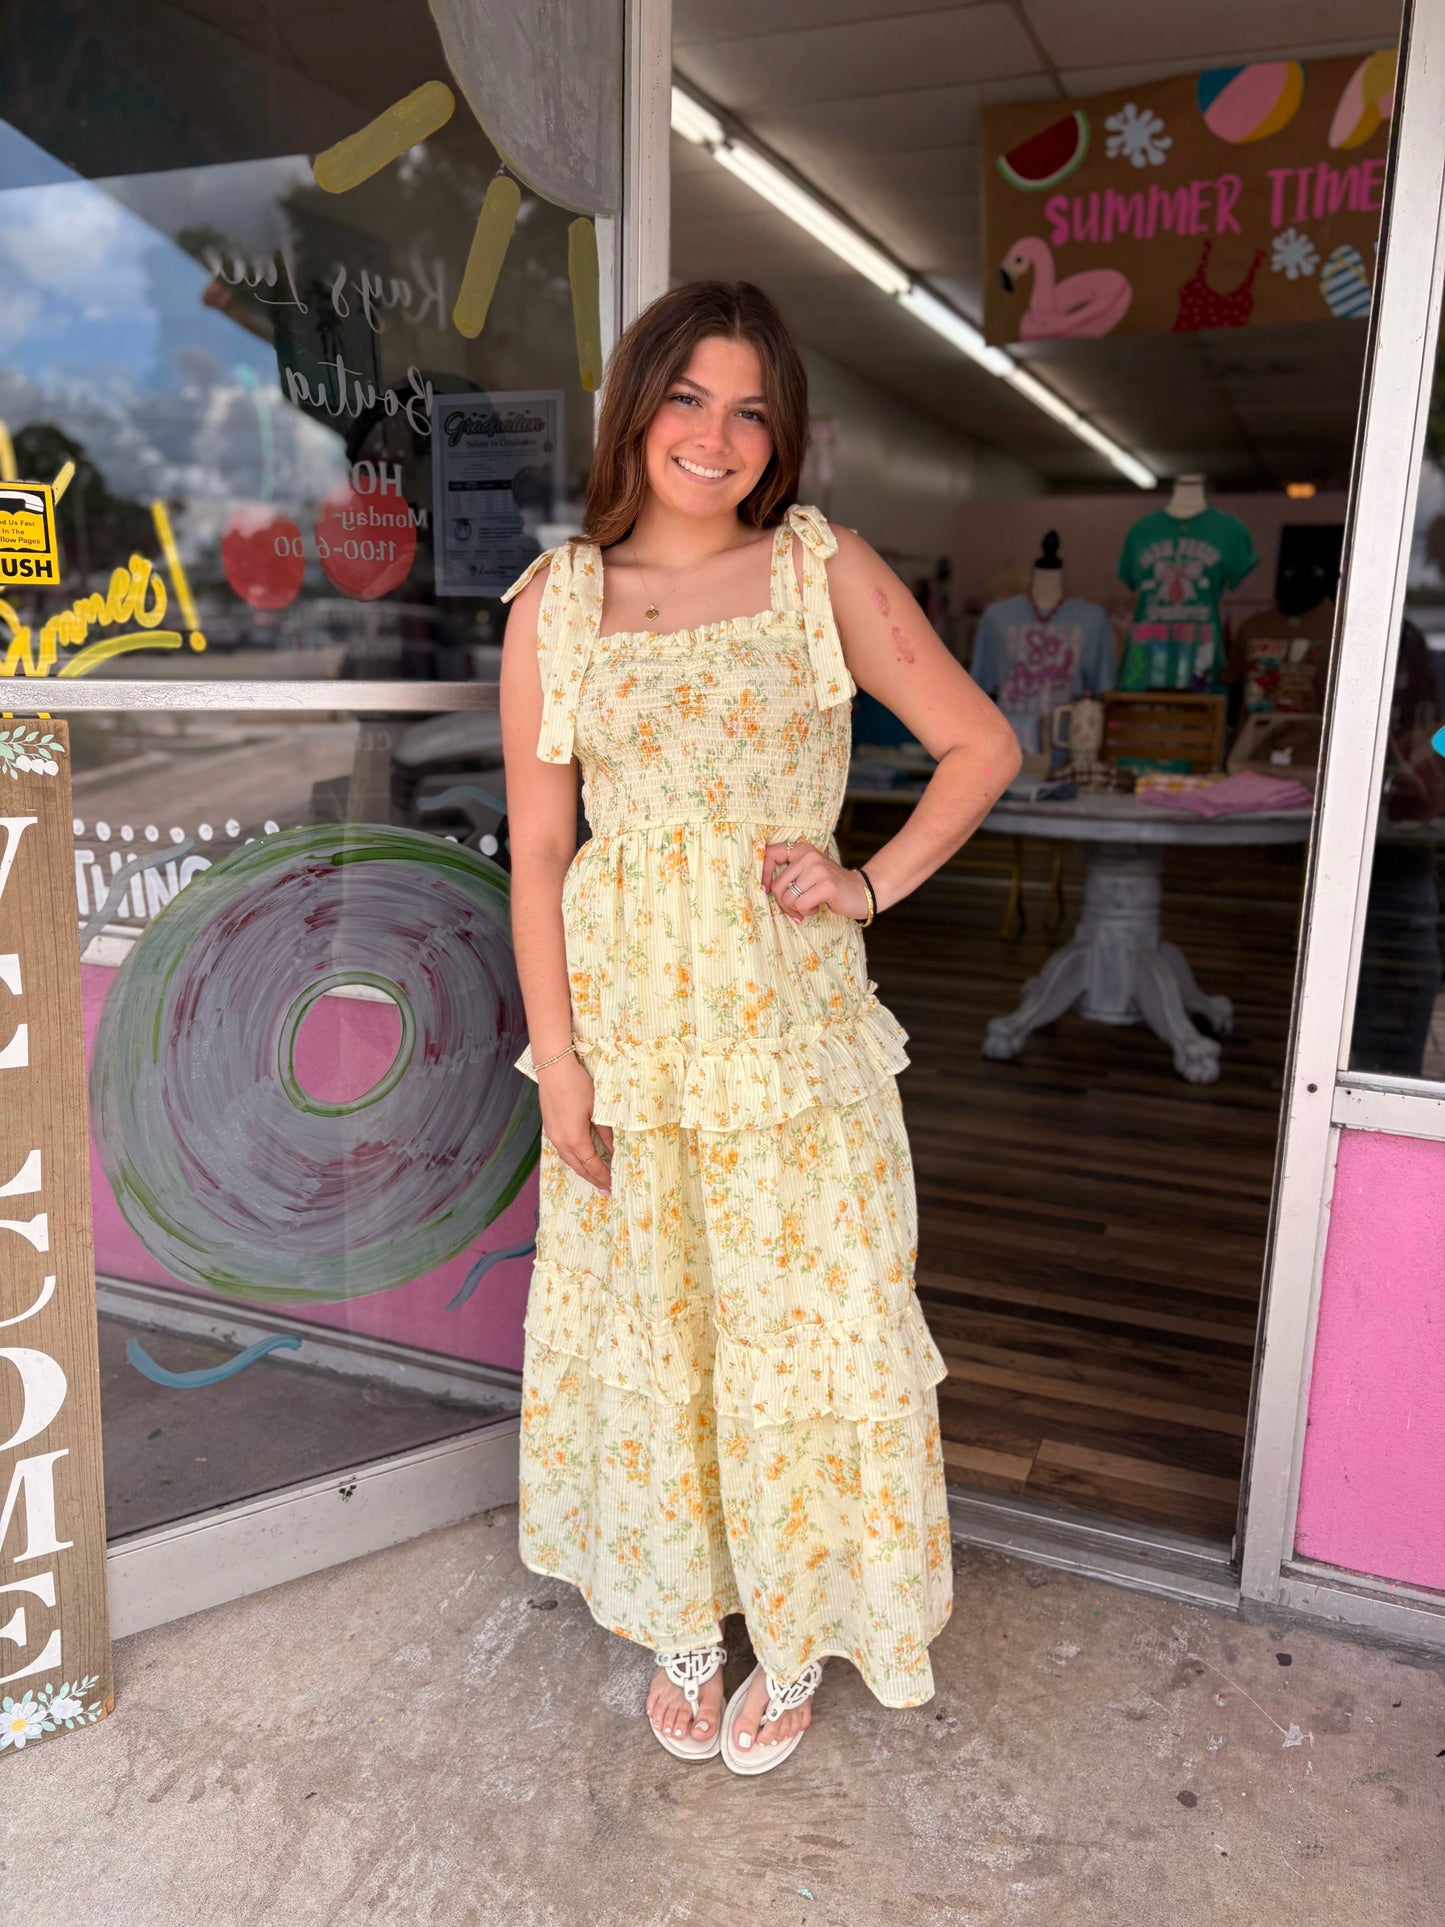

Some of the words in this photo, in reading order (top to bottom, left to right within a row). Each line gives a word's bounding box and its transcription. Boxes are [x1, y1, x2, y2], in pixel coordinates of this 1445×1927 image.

[1044, 174, 1243, 247] SUMMER
[1265, 159, 1386, 229] TIME
[18, 537, 41, 545] Pages
[1, 558, 53, 578] USH
